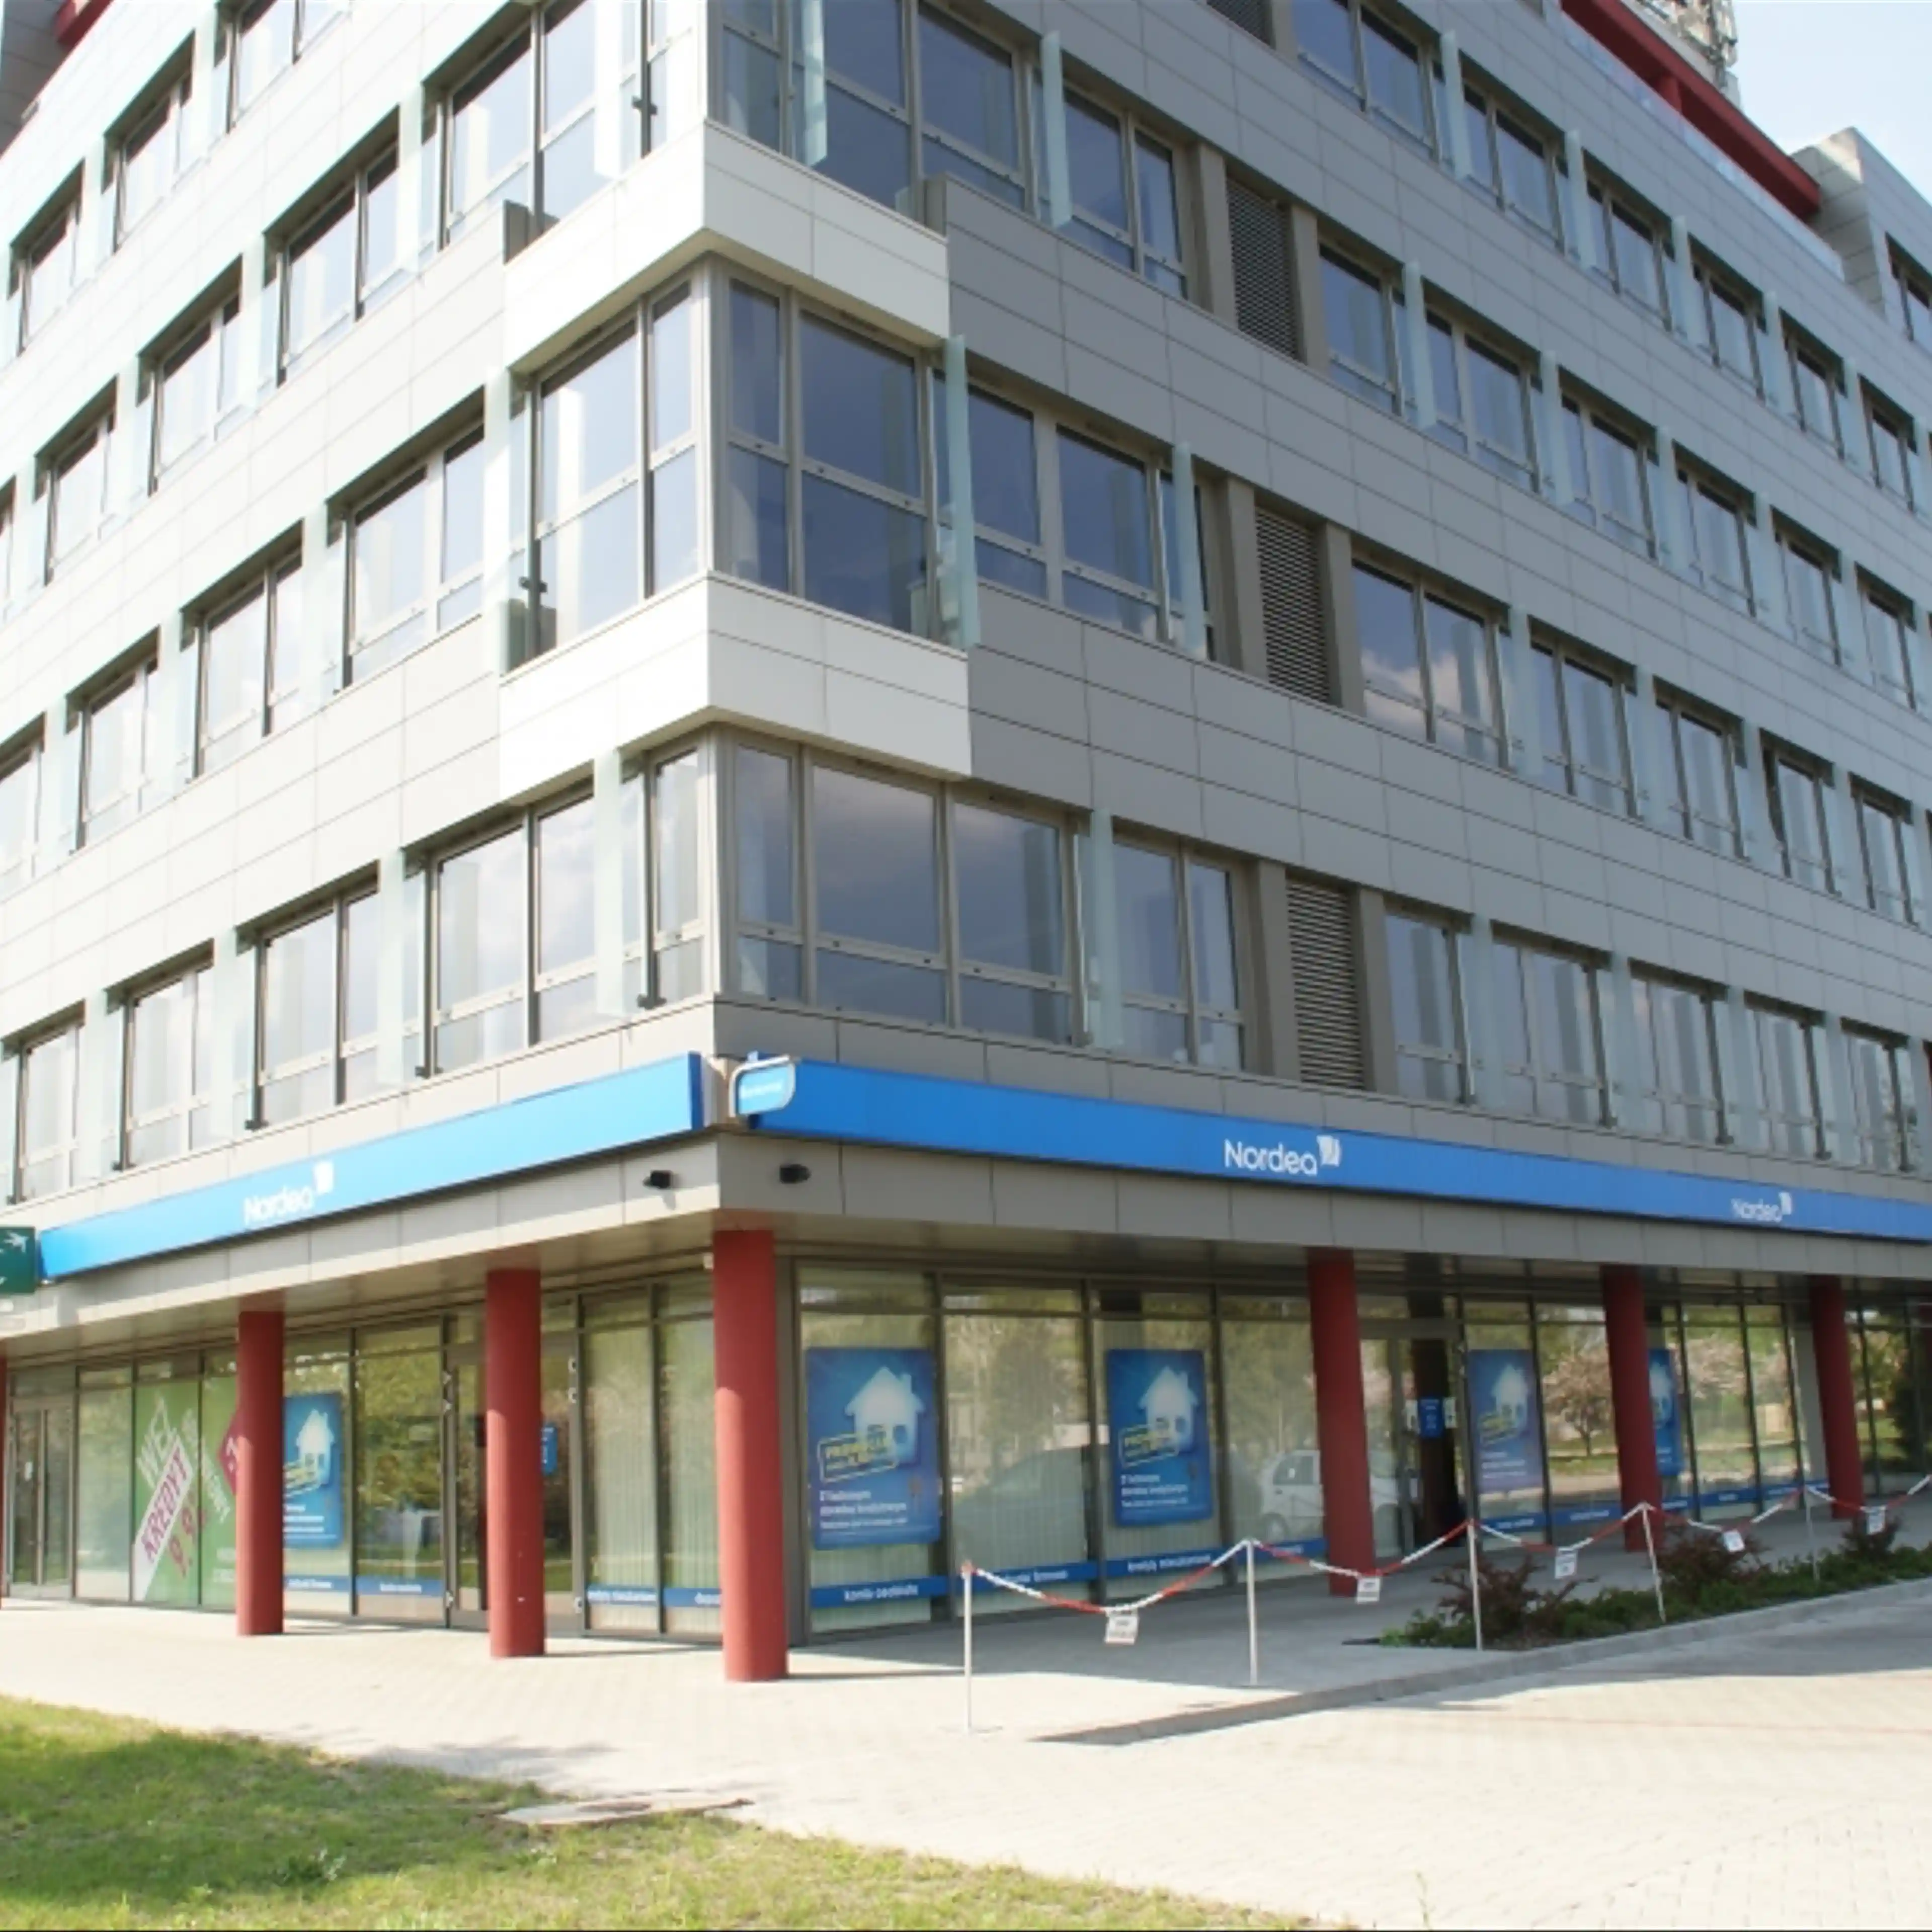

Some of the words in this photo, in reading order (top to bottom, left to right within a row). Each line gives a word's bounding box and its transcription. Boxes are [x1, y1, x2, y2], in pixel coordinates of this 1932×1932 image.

[1224, 1139, 1318, 1176] Nordea
[244, 1185, 314, 1227] Nordea
[1731, 1198, 1783, 1223] Nordea
